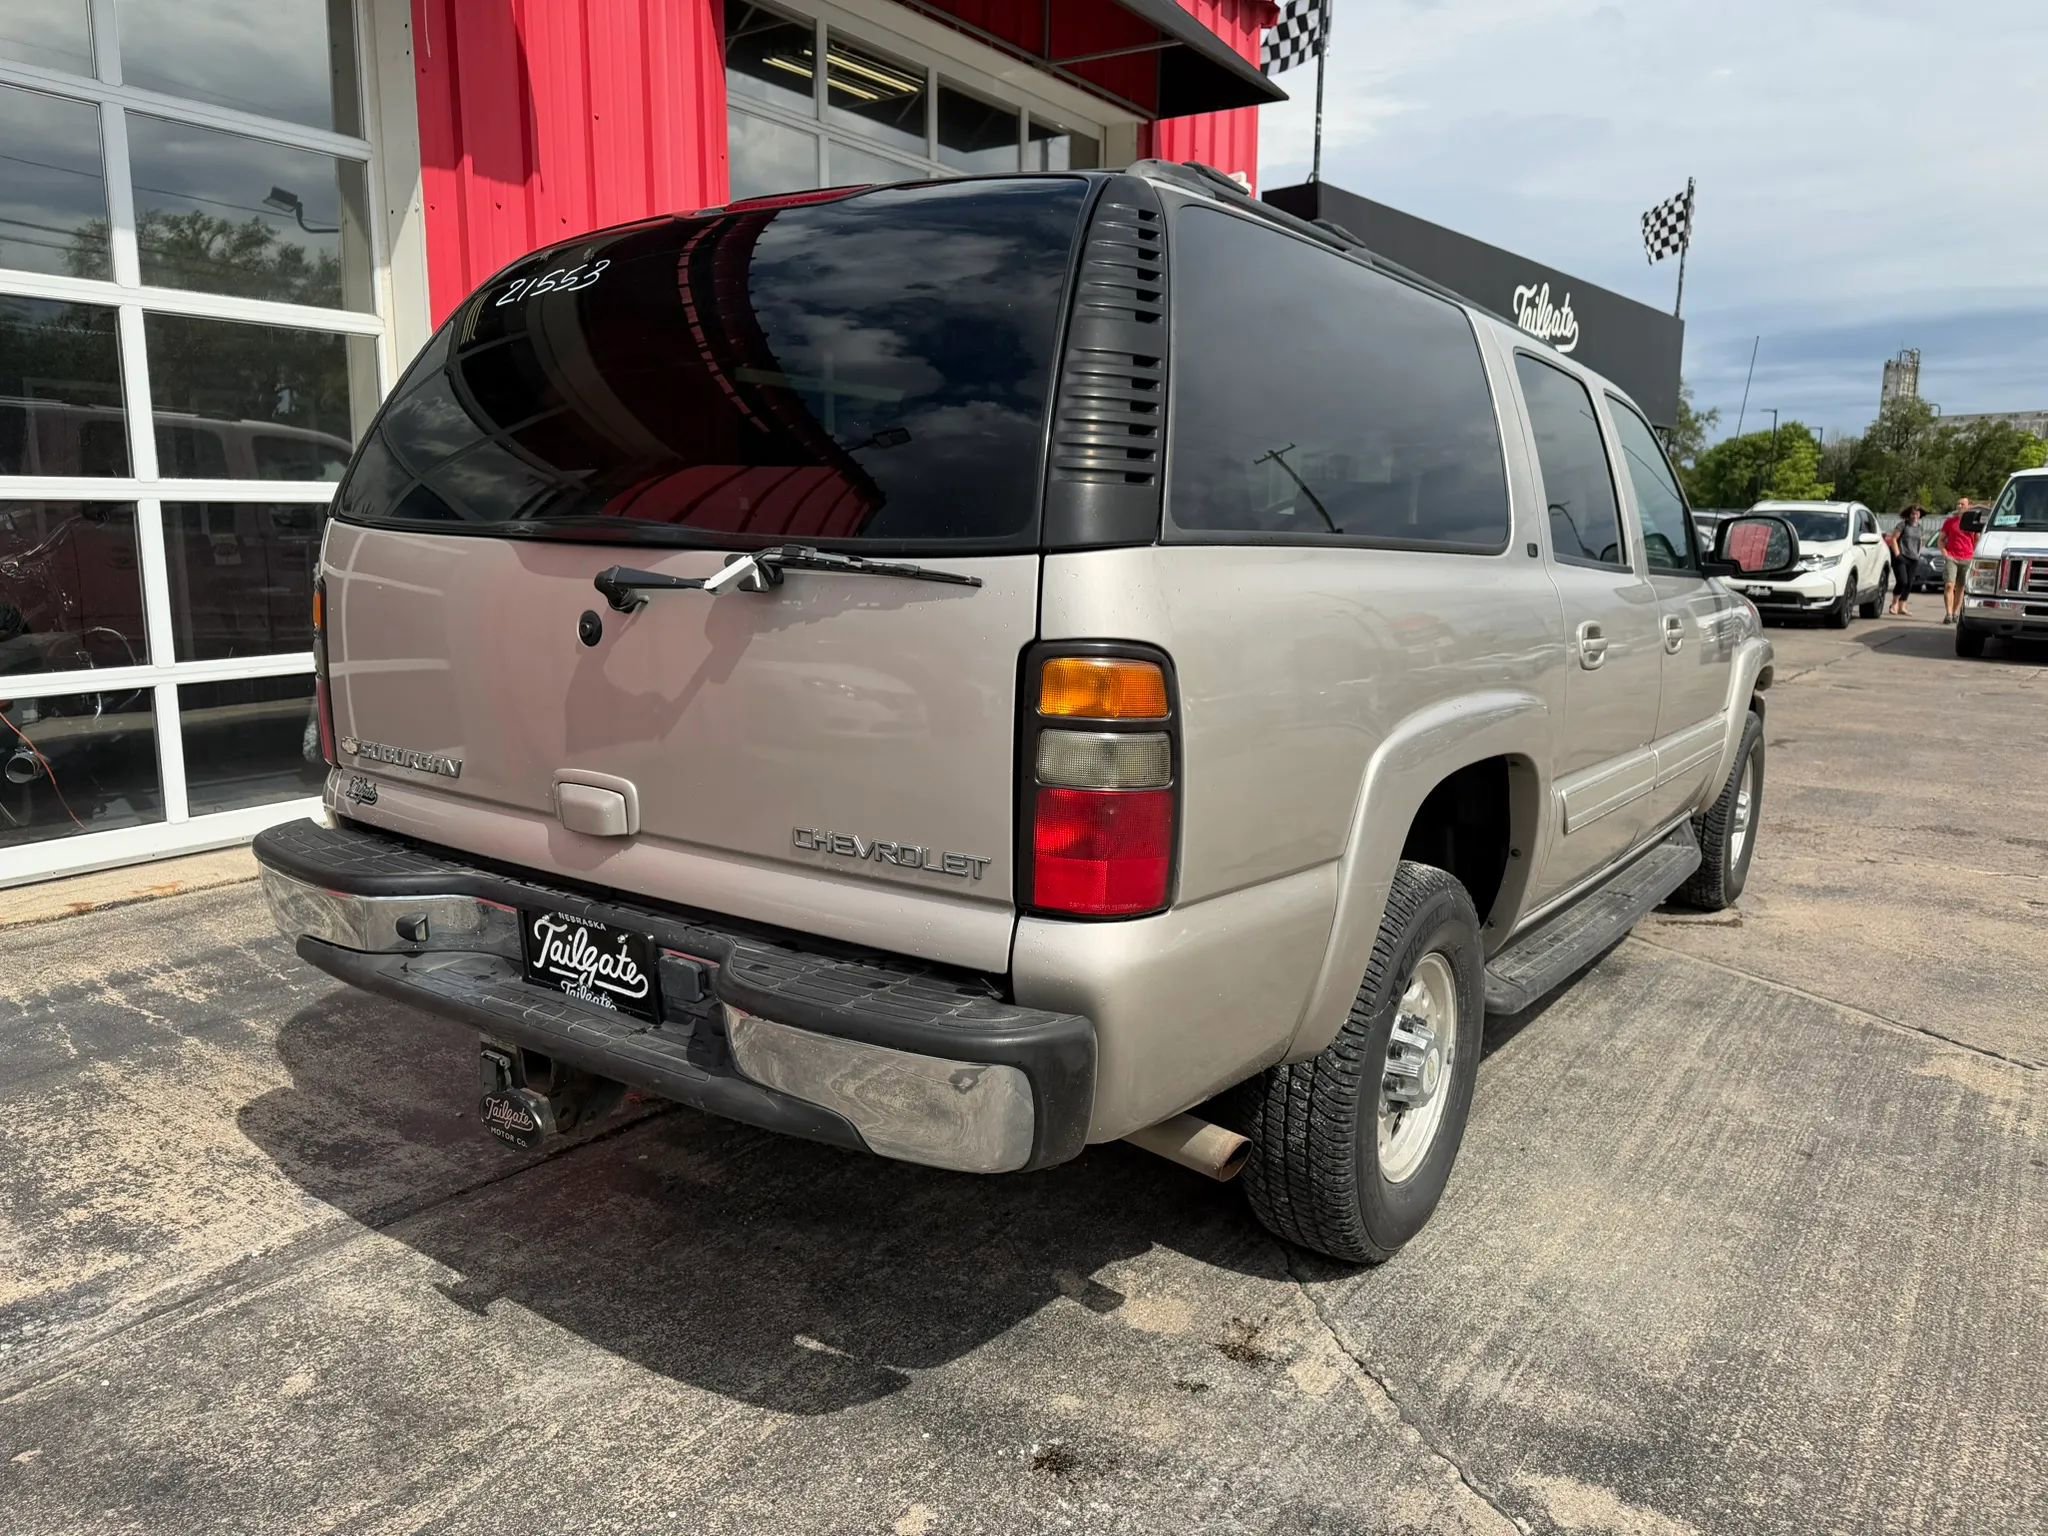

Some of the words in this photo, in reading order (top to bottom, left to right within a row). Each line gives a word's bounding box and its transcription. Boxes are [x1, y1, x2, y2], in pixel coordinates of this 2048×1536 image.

[496, 259, 611, 306] 21553
[1513, 282, 1579, 353] Tailgate
[359, 740, 463, 779] SUBURBAN
[792, 826, 992, 881] CHEVROLET
[557, 911, 607, 931] NEBRASKA
[533, 918, 649, 999] Tailgate
[485, 1097, 534, 1132] Tailgate
[490, 1126, 515, 1143] MOTOR
[516, 1137, 528, 1148] CO.
